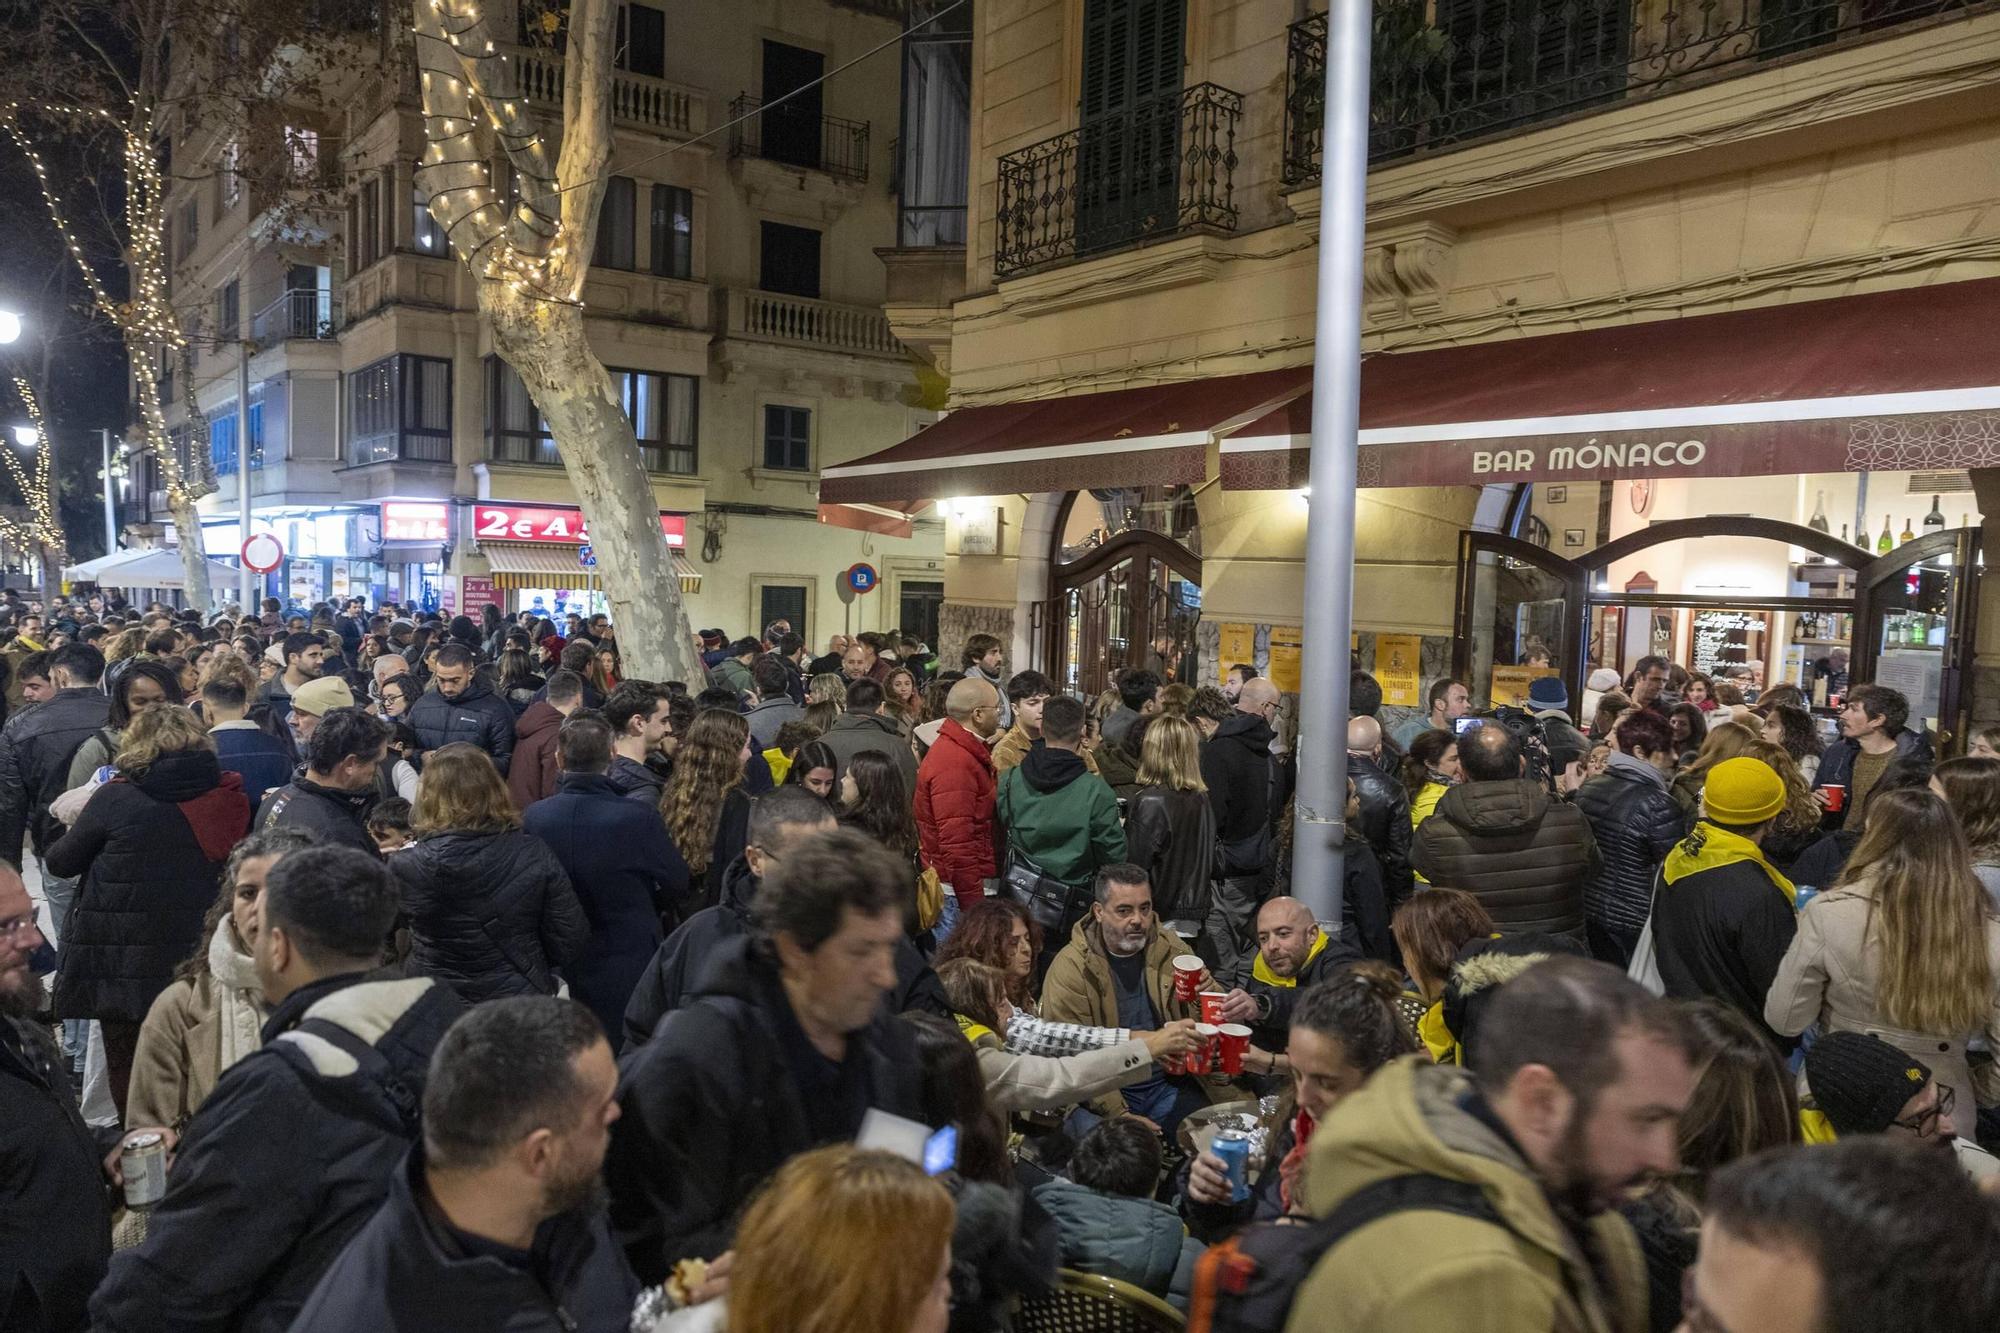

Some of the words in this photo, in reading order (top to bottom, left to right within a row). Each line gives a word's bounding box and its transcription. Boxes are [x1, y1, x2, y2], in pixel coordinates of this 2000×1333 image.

[1473, 450, 1535, 473] BAR
[1548, 438, 1707, 470] MÓNACO
[478, 510, 533, 537] 2€
[540, 517, 570, 536] A
